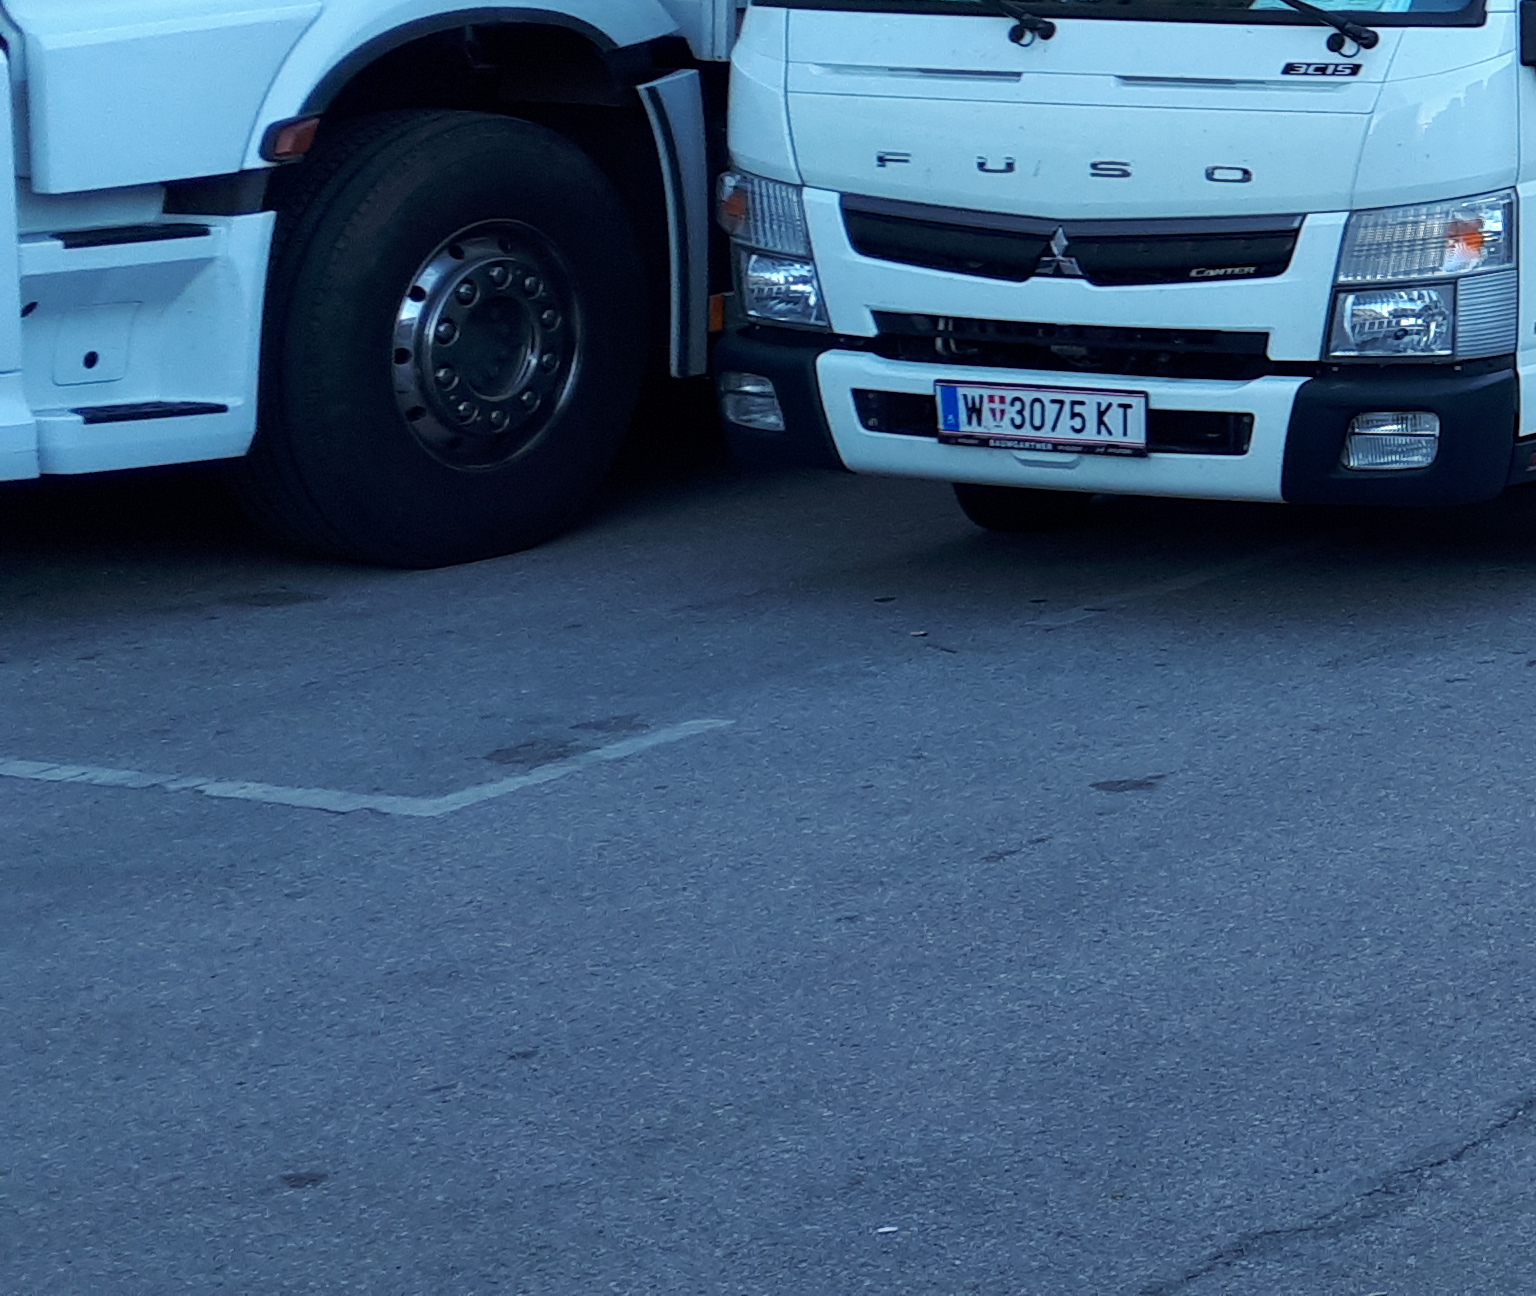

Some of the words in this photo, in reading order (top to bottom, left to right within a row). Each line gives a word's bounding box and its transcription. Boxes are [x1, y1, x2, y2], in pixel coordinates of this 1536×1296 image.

[1288, 63, 1353, 76] 3C15
[875, 150, 1253, 184] FUSO
[961, 393, 985, 427] W
[1009, 395, 1087, 434] 3075
[1096, 400, 1133, 437] KT
